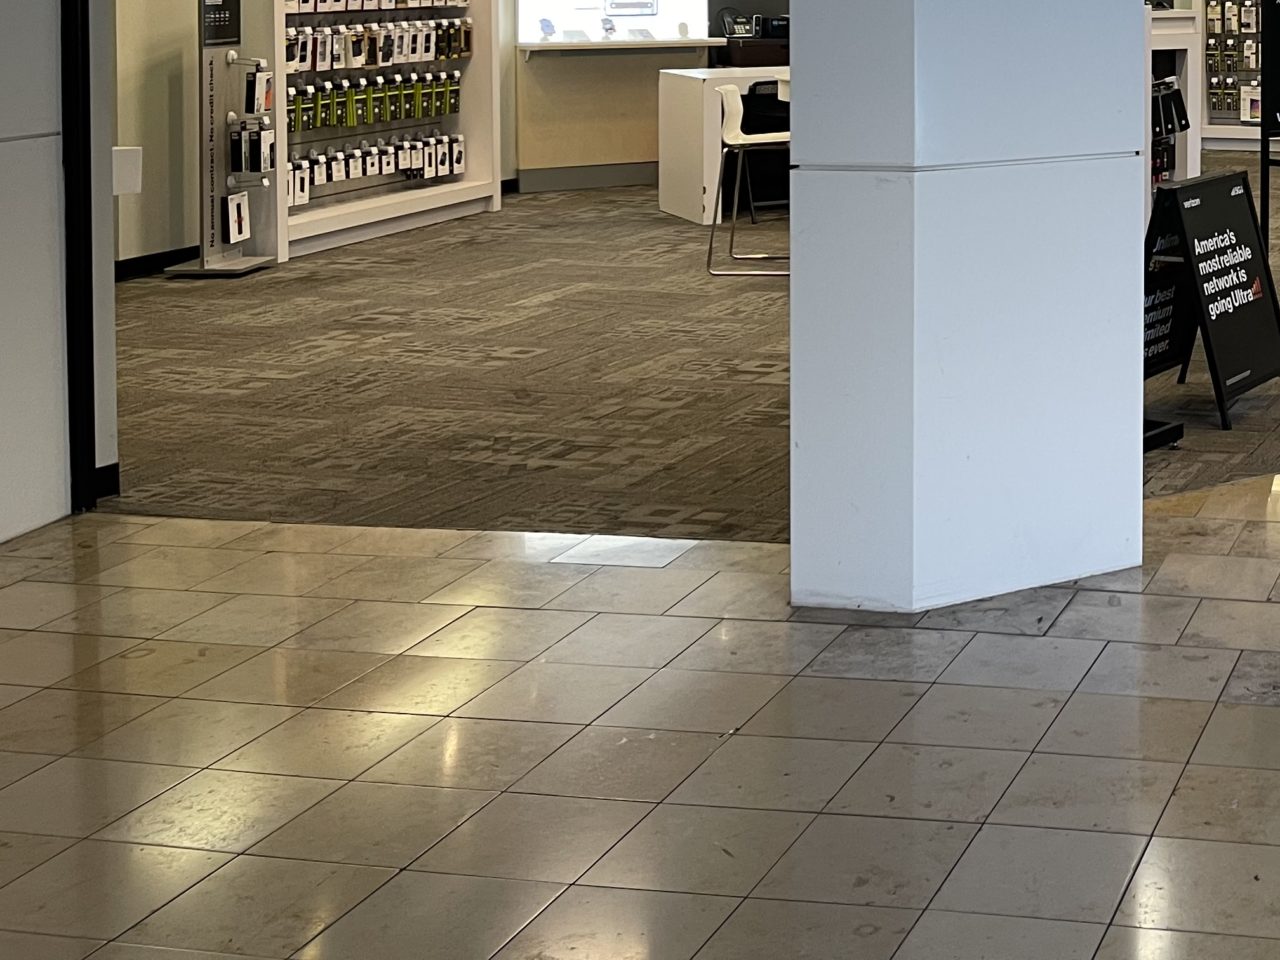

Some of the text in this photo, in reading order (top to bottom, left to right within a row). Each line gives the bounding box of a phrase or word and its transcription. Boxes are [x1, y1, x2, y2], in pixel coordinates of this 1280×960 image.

[1194, 228, 1237, 256] America's
[1198, 244, 1252, 276] most reliable
[1203, 267, 1248, 296] network is
[1144, 285, 1176, 308] ur best
[1208, 287, 1254, 320] going Ultra
[1144, 305, 1173, 324] emium
[1144, 318, 1173, 342] imited
[1148, 338, 1170, 358] ever.
